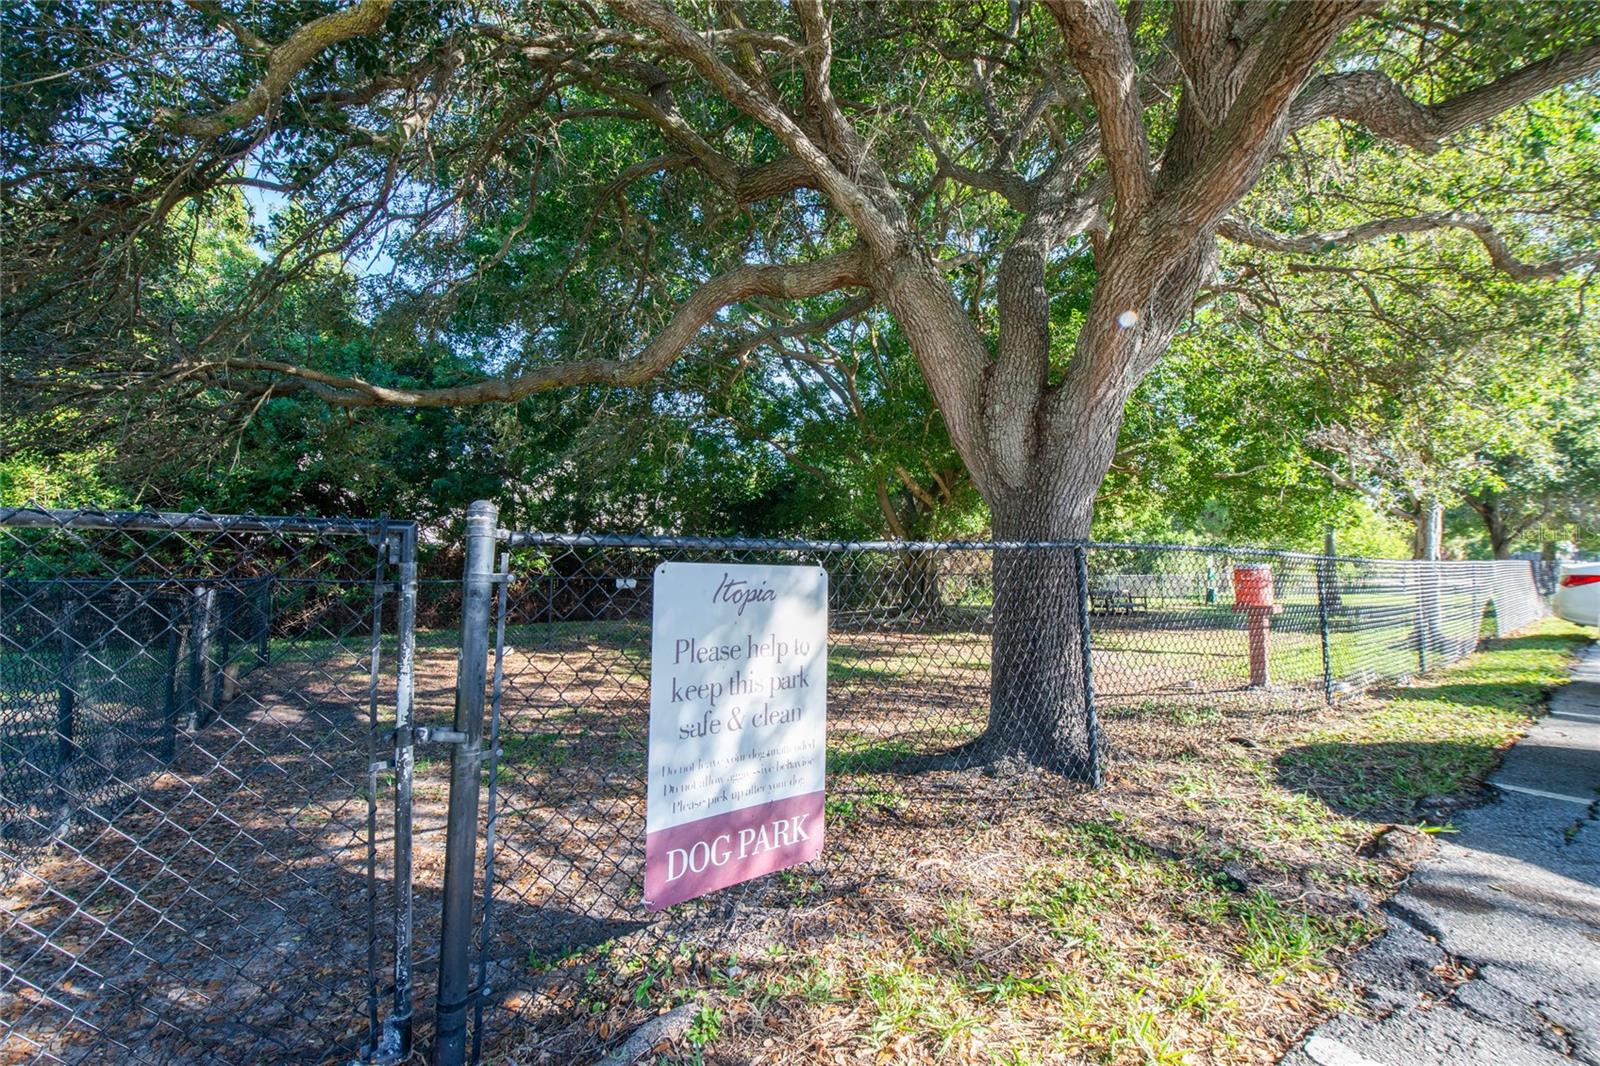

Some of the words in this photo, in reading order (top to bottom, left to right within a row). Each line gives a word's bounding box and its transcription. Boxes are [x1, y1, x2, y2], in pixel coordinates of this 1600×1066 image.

[712, 572, 777, 616] Itopia
[673, 637, 742, 664] Please
[747, 633, 789, 664] help
[794, 637, 811, 656] to
[671, 677, 723, 707] keep
[729, 670, 764, 696] this
[769, 665, 810, 698] park
[678, 709, 721, 740] safe
[727, 706, 744, 732] &
[752, 703, 802, 729] clean
[661, 765, 677, 778] Do
[679, 761, 695, 774] not
[663, 784, 678, 797] Do
[672, 799, 705, 814] Please
[707, 790, 729, 809] pick
[666, 834, 732, 883] DOG
[737, 814, 811, 860] PARK
